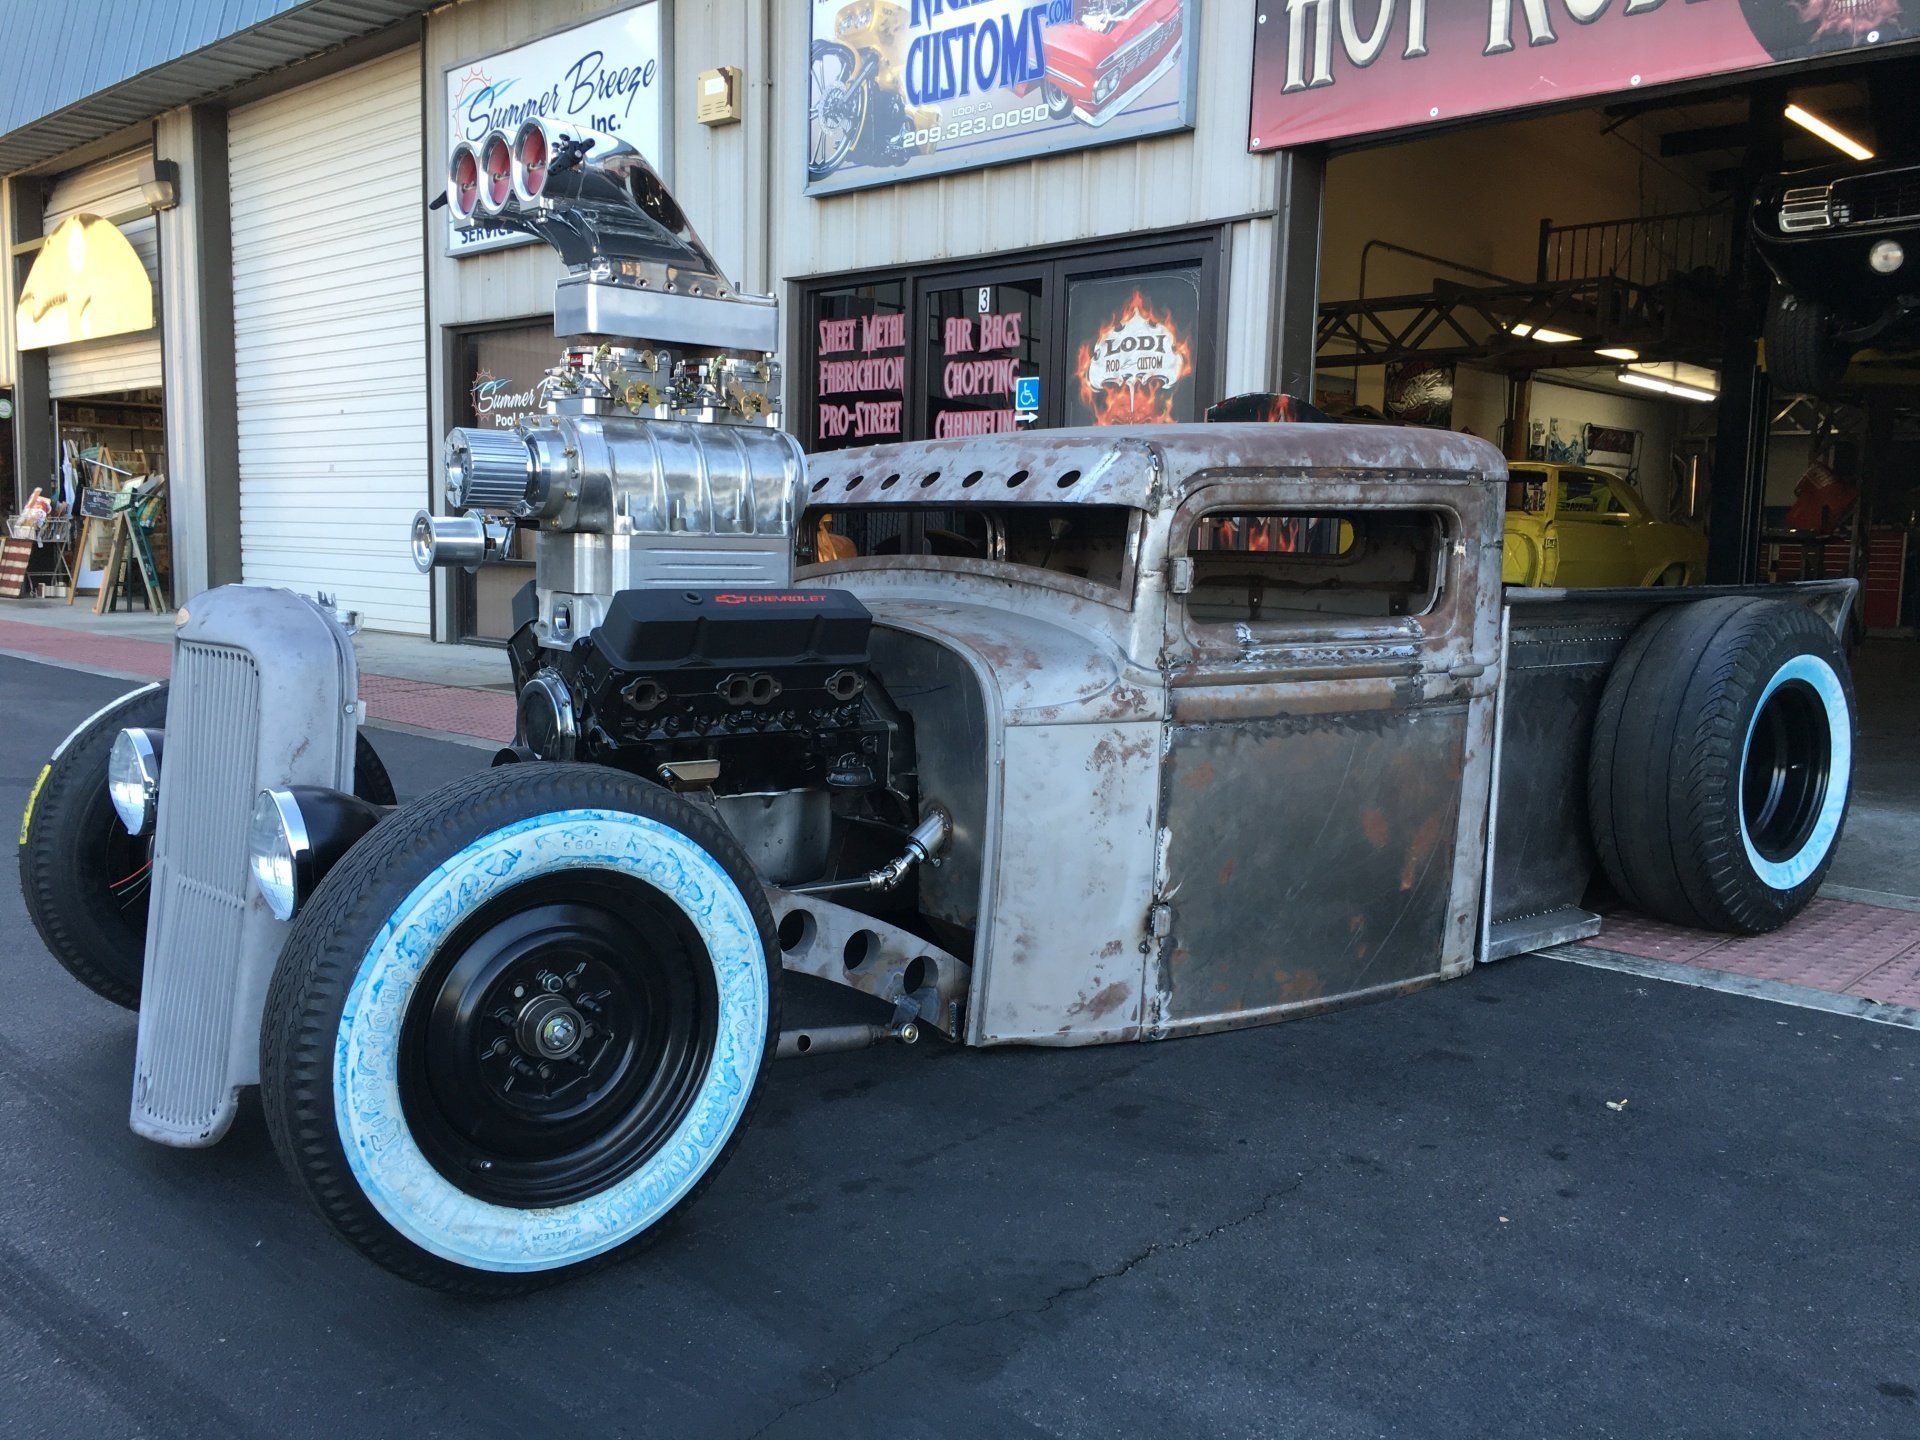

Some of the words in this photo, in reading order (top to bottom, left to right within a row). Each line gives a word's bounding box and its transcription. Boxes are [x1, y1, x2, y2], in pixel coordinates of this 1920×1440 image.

[906, 3, 1046, 107] CUSTOMS
[466, 84, 561, 141] Summer
[565, 50, 657, 118] Breeze
[952, 105, 977, 117] LODI,
[978, 102, 993, 112] CA
[591, 113, 621, 133] Inc.
[902, 103, 1050, 149] 209.323.0090
[980, 289, 990, 312] 3
[819, 319, 857, 356] SHEET
[862, 313, 906, 358] METAL
[944, 317, 974, 356] AIR
[979, 312, 1022, 354] BAGS
[1104, 335, 1167, 357] LODI
[819, 357, 906, 398] FABRICATION
[943, 358, 1020, 401] CHOPPING
[1106, 359, 1120, 373] ROD
[1137, 356, 1163, 371] CUSTOM
[478, 380, 536, 413] Summer
[819, 401, 903, 440] PRO-STREET
